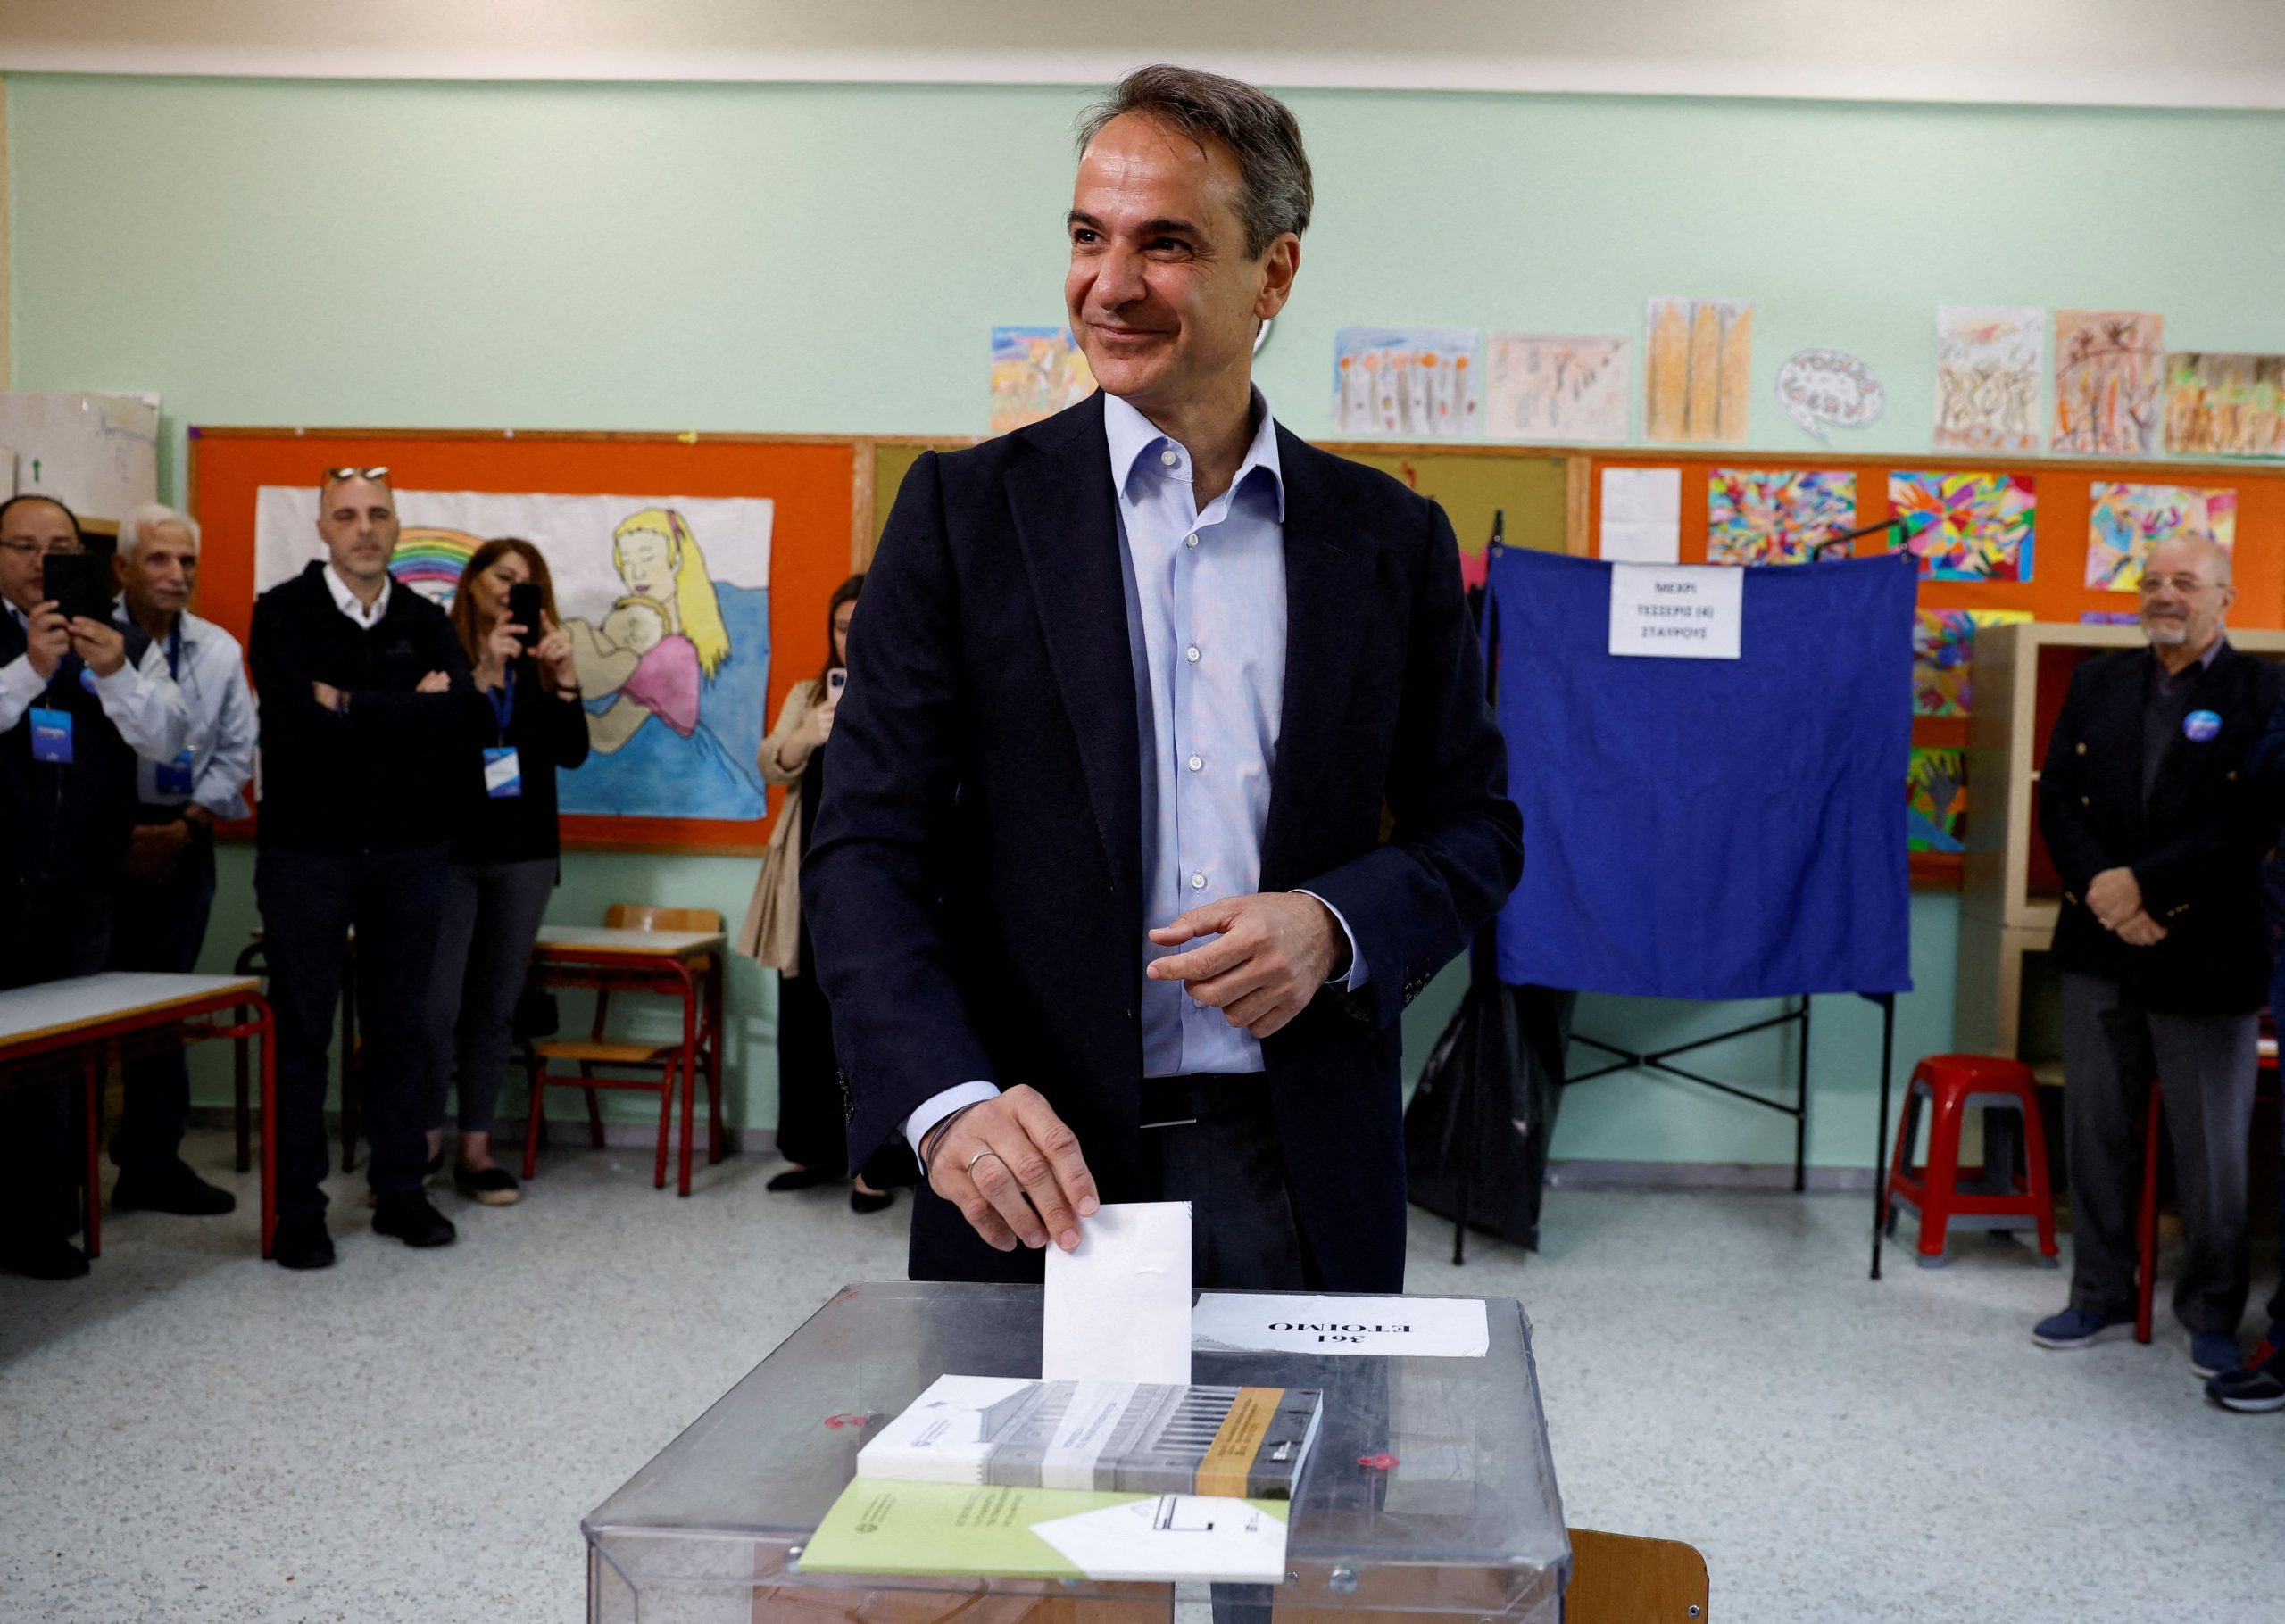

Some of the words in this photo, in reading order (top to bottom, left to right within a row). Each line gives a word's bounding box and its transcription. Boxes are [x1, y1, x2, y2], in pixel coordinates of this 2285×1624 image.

[1655, 583, 1697, 593] ΜΕΧΡΙ
[1637, 604, 1692, 617] ΤΕΣΣΕΡΙΣ
[1696, 606, 1714, 619] (4)
[1641, 626, 1707, 639] ΣΤΑΥΡΟΥΣ
[1268, 1322, 1411, 1333] ΕΤΟΙΜΟ
[1318, 1334, 1366, 1343] 361
